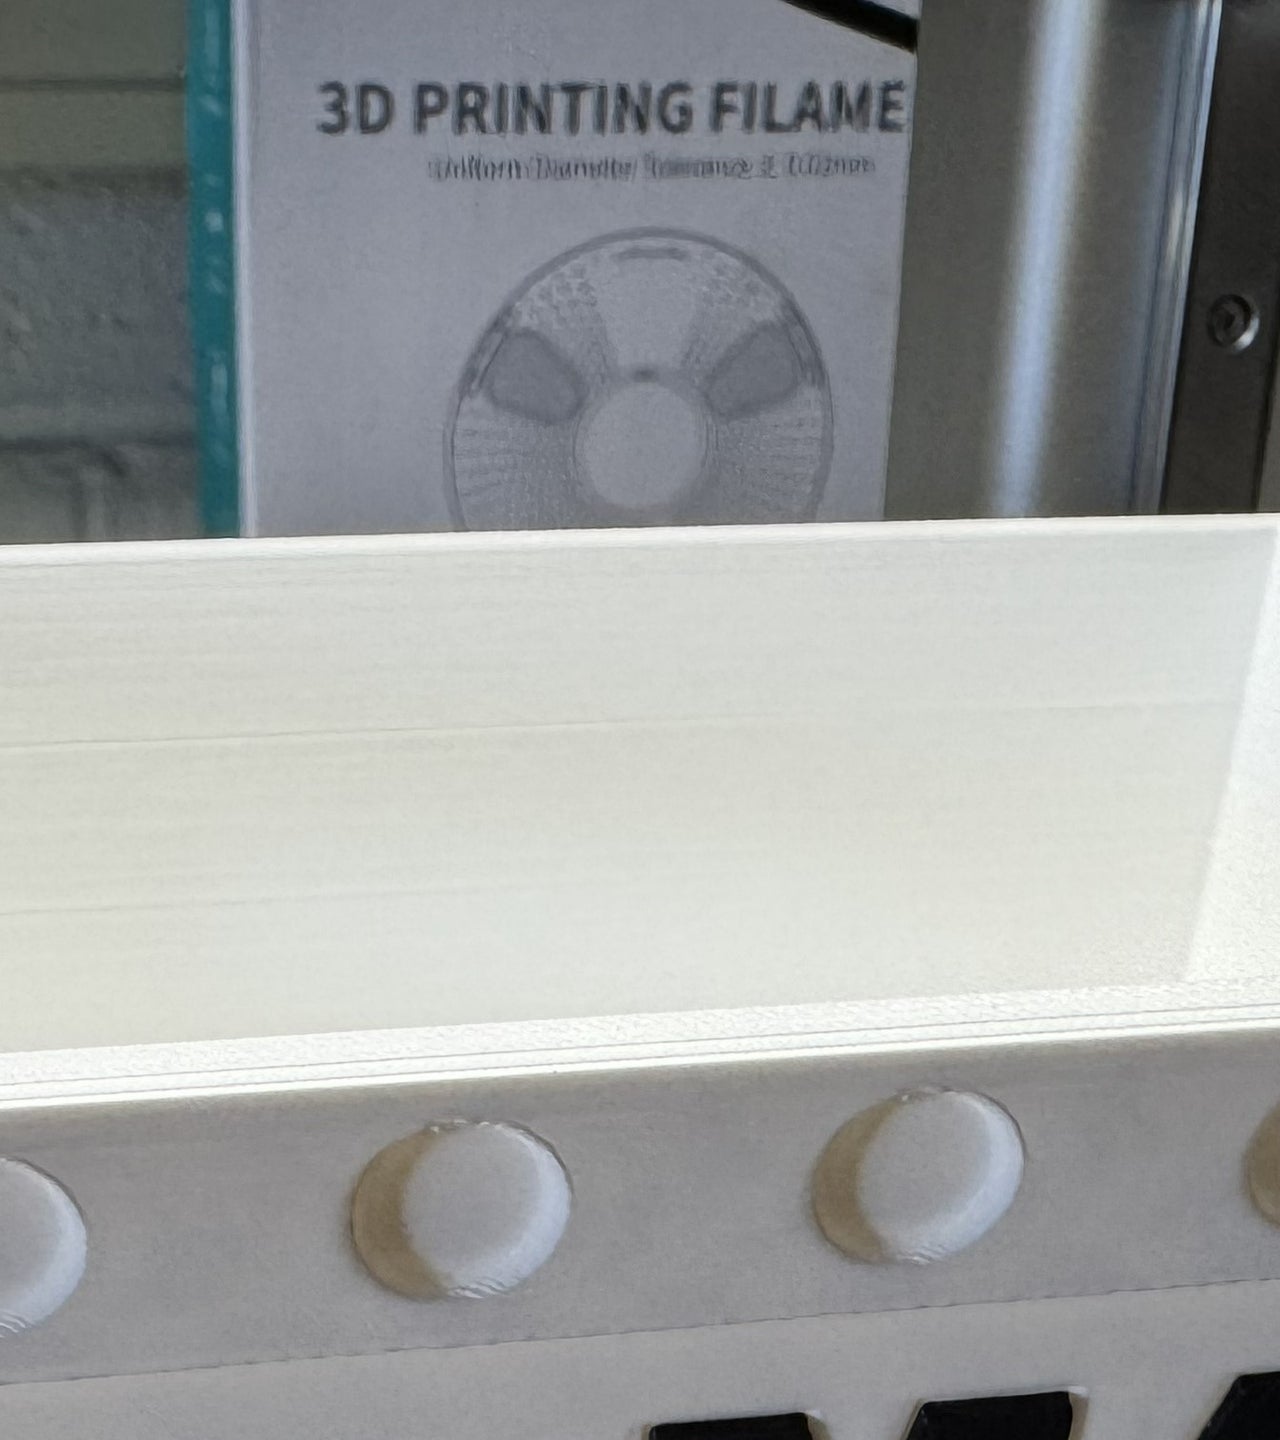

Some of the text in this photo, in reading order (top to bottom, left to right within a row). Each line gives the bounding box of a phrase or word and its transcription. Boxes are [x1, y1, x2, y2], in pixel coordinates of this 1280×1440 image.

[316, 79, 907, 134] 3D PRINTING FILAME
